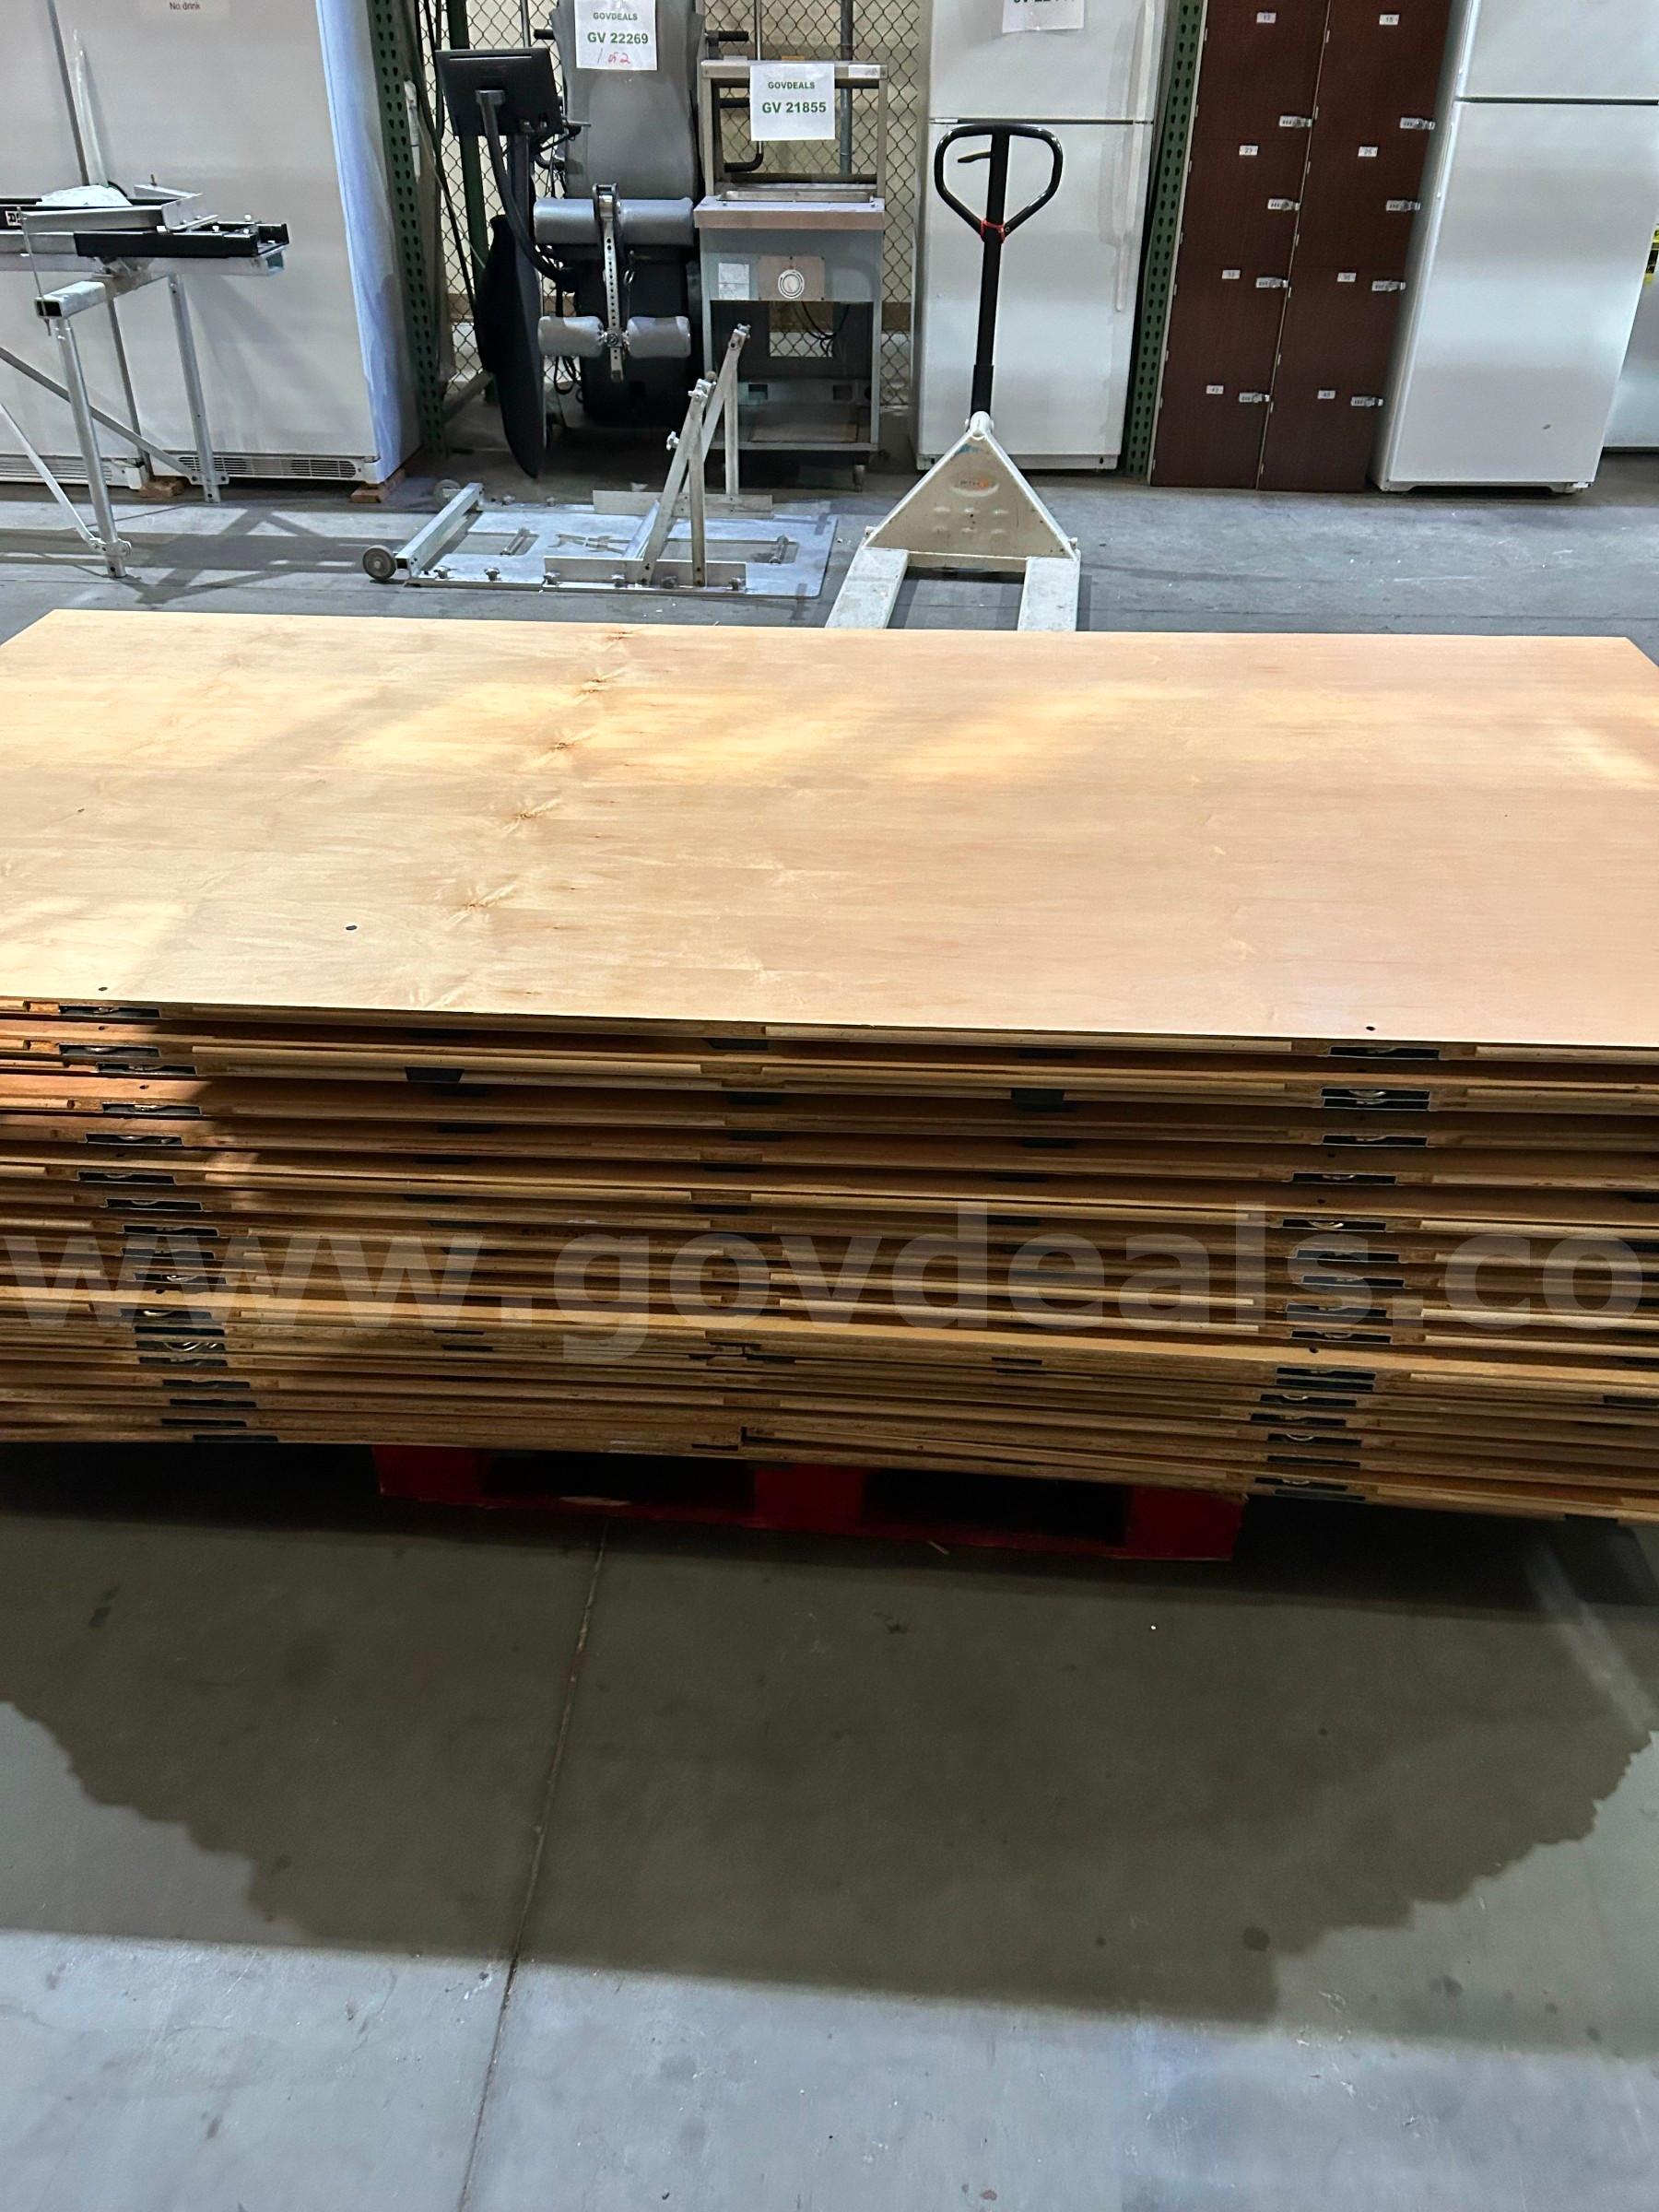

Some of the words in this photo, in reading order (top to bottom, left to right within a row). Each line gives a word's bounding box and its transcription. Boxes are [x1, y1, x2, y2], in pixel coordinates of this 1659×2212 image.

[593, 12, 638, 20] GOVDEALS
[587, 32, 606, 42] GV
[610, 32, 649, 44] 22269
[768, 81, 816, 89] GOVDEALS
[762, 102, 782, 112] GV
[785, 101, 827, 112] 21855
